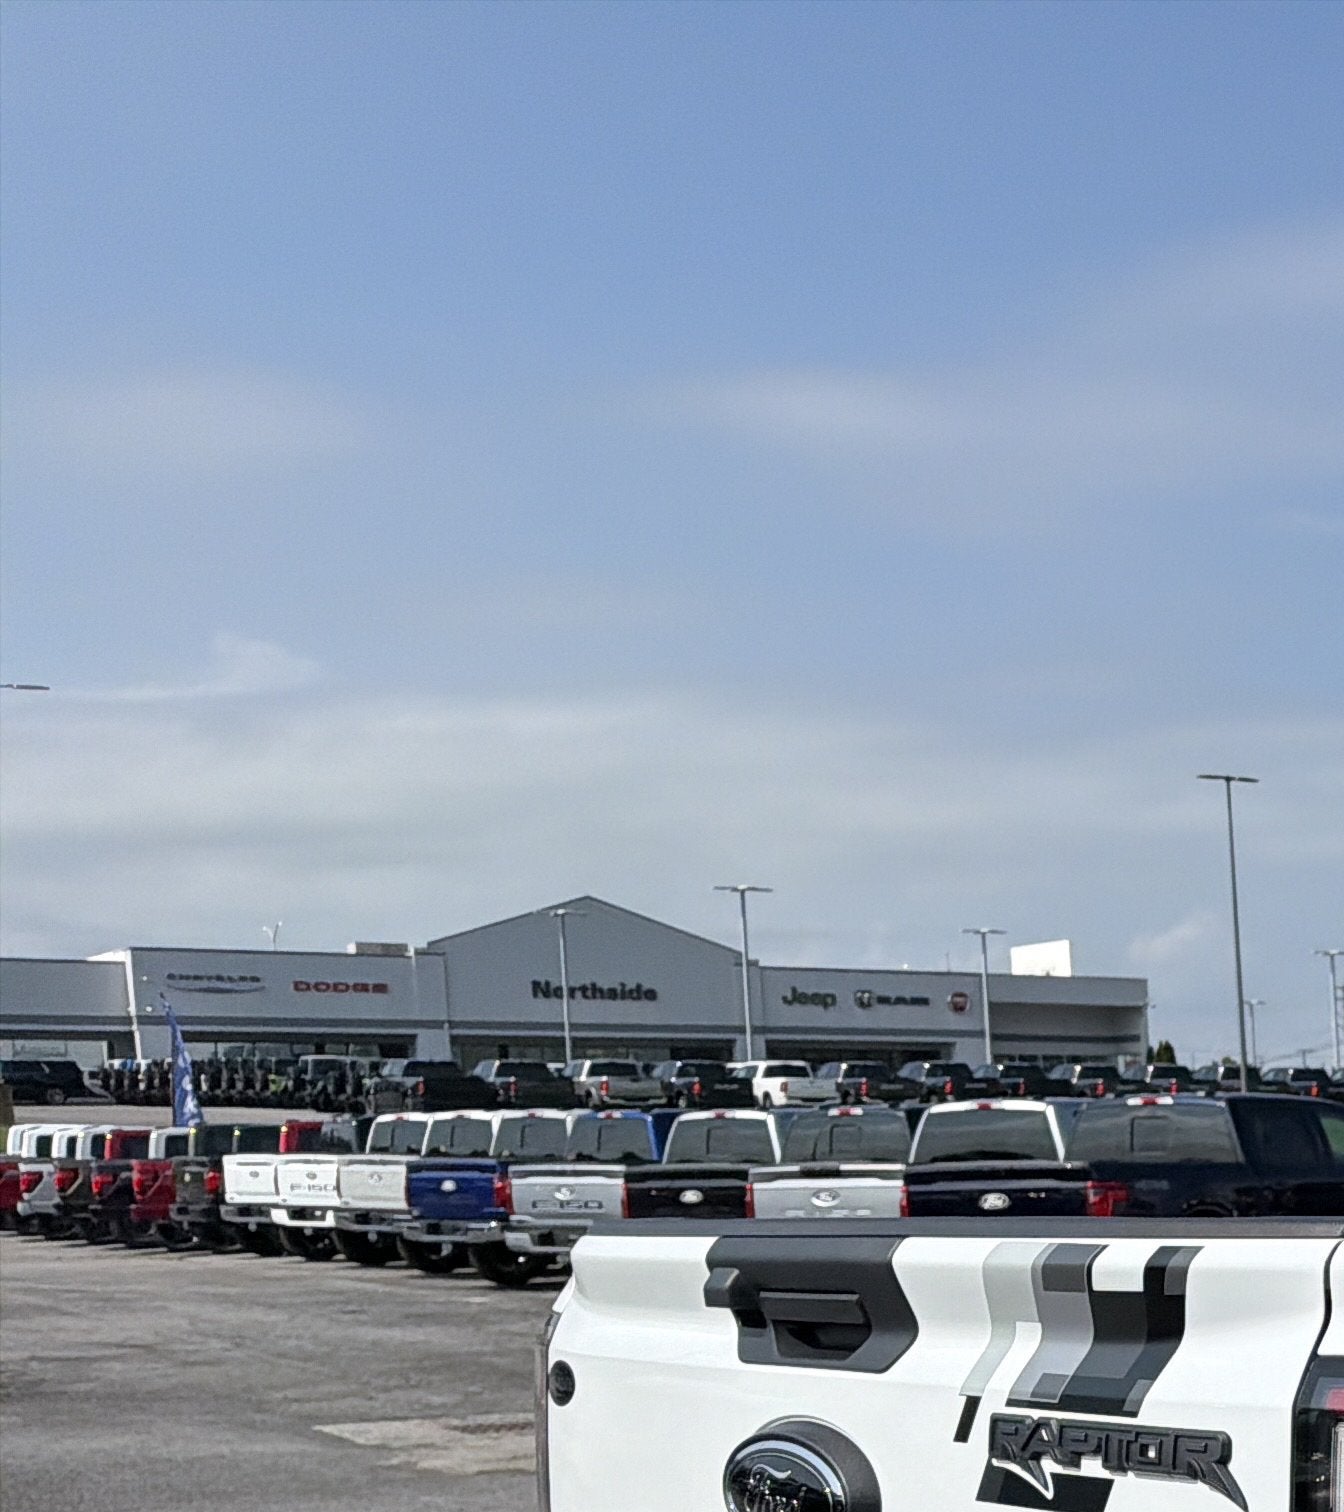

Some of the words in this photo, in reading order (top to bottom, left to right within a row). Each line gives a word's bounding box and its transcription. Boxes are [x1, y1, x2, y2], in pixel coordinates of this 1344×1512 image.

[293, 980, 389, 994] DODGE
[531, 980, 658, 1001] Northside
[782, 986, 837, 1010] Jeep
